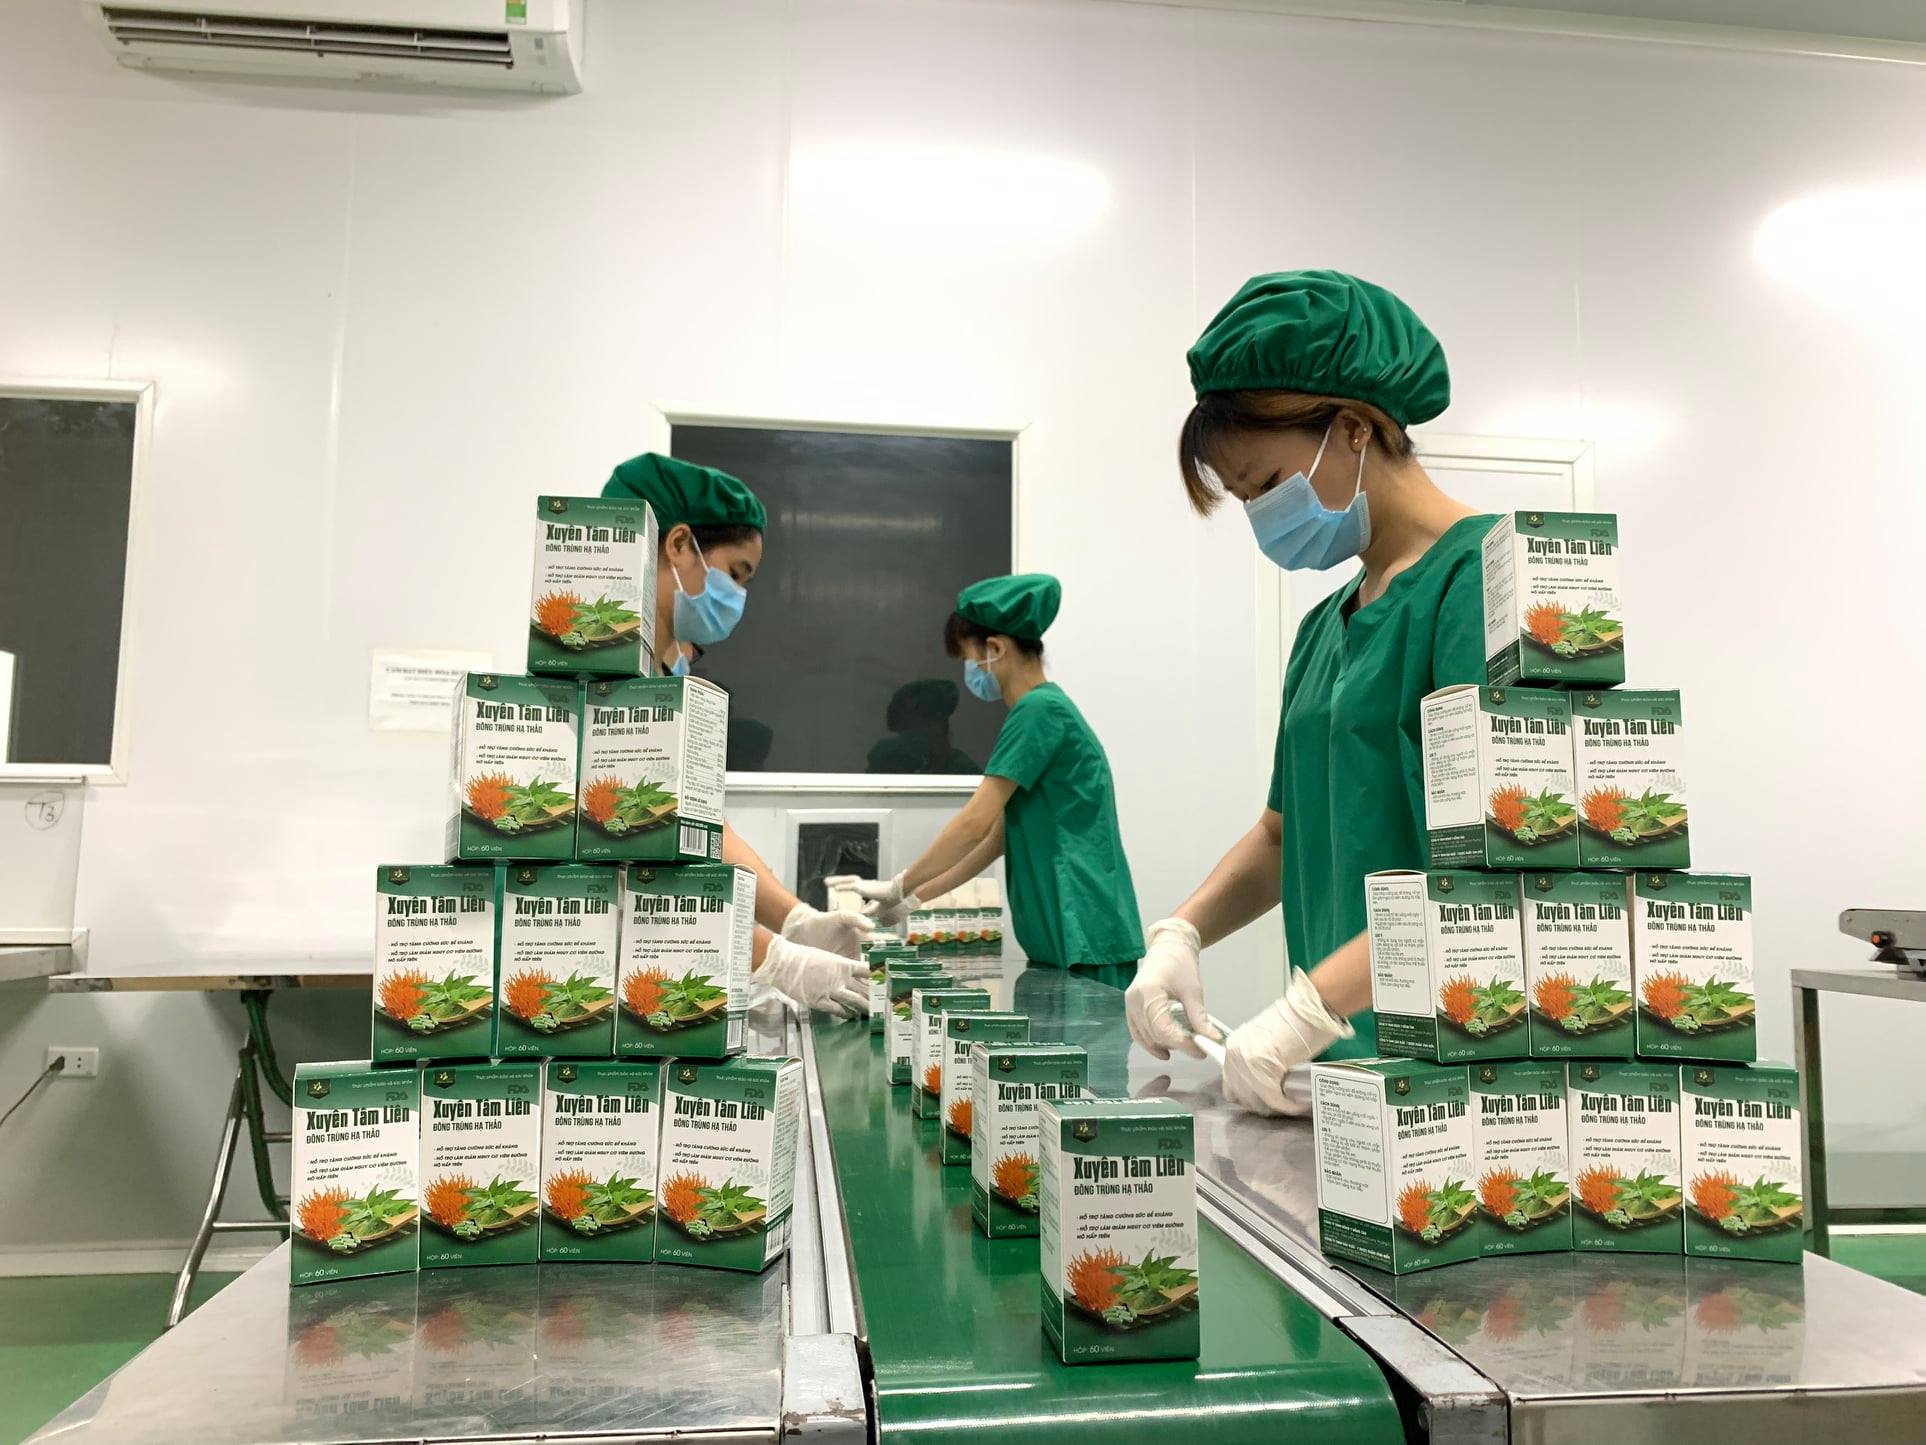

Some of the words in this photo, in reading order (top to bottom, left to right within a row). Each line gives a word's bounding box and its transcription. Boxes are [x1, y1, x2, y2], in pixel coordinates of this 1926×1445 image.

[546, 524, 582, 544] Xuyên
[585, 525, 609, 542] Tâm
[612, 527, 636, 543] Liên
[1527, 538, 1561, 556] Xuyên
[1564, 539, 1586, 555] Tâm
[1589, 540, 1612, 556] Liên
[476, 701, 514, 723] Xuyên
[518, 704, 542, 721] Tâm
[546, 705, 570, 723] Liên
[593, 707, 625, 727] Xuyên
[628, 706, 649, 723] Tâm
[652, 705, 674, 722] Liên
[1491, 715, 1521, 736] Xuyên
[1524, 717, 1544, 734] Tâm
[1546, 718, 1566, 735] Liên
[1584, 719, 1620, 738] Xuyên
[1623, 719, 1647, 735] Tâm
[1650, 718, 1674, 735] Liên
[388, 896, 427, 917] Xuyên
[431, 895, 456, 913] Tâm
[460, 895, 485, 913] Liên
[515, 897, 553, 917] Xuyên
[556, 897, 581, 914] Tâm
[584, 897, 609, 914] Liên
[634, 895, 670, 915] Xuyên
[673, 895, 697, 912] Tâm
[700, 895, 724, 913] Liên
[1439, 904, 1470, 925] Xuyên
[1472, 903, 1492, 921] Tâm
[1494, 903, 1514, 920] Liên
[1536, 903, 1570, 923] Xuyên
[1573, 903, 1595, 920] Tâm
[1599, 903, 1621, 920] Liên
[1647, 901, 1684, 922] Xuyên
[1688, 902, 1713, 920] Tâm
[1717, 903, 1743, 921] Liên
[928, 1016, 942, 1029] Xuy
[954, 1041, 971, 1057] Xuy
[998, 1083, 1031, 1103] Xuyên
[1034, 1082, 1056, 1099] Tâm
[1059, 1082, 1081, 1099] Liên
[433, 1099, 472, 1121] Xuyên
[476, 1098, 501, 1117] Tâm
[505, 1097, 530, 1116] Liên
[556, 1095, 593, 1116] Xuyên
[596, 1095, 621, 1113] Tâm
[624, 1095, 649, 1113] Liên
[675, 1096, 711, 1120] Xuyên
[713, 1099, 738, 1118] Tâm
[740, 1101, 765, 1121] Liên
[1481, 1095, 1513, 1116] Xuyên
[1516, 1093, 1536, 1111] Tâm
[1539, 1092, 1560, 1110] Liên
[1581, 1093, 1617, 1114] Xuyên
[1620, 1094, 1644, 1112] Tâm
[1648, 1095, 1671, 1113] Liên
[1695, 1097, 1733, 1120] Xuyên
[1737, 1099, 1762, 1118] Tâm
[1766, 1101, 1791, 1120] Liên
[307, 1109, 348, 1134] Xuyên
[352, 1106, 379, 1126] Tâm
[383, 1103, 409, 1124] Liên
[1397, 1105, 1425, 1130] Xuyên
[1427, 1102, 1445, 1122] Tâm
[1447, 1099, 1465, 1119] Liên
[1074, 1156, 1118, 1183] Xuyên
[1122, 1155, 1151, 1178] Tâm
[1156, 1154, 1184, 1177] Liên
[1074, 1184, 1094, 1195] ĐÔNG
[1097, 1183, 1120, 1195] TRÙNG
[1122, 1184, 1132, 1196] HẠ
[1134, 1180, 1153, 1193] THẢO
[1090, 1345, 1100, 1353] 60
